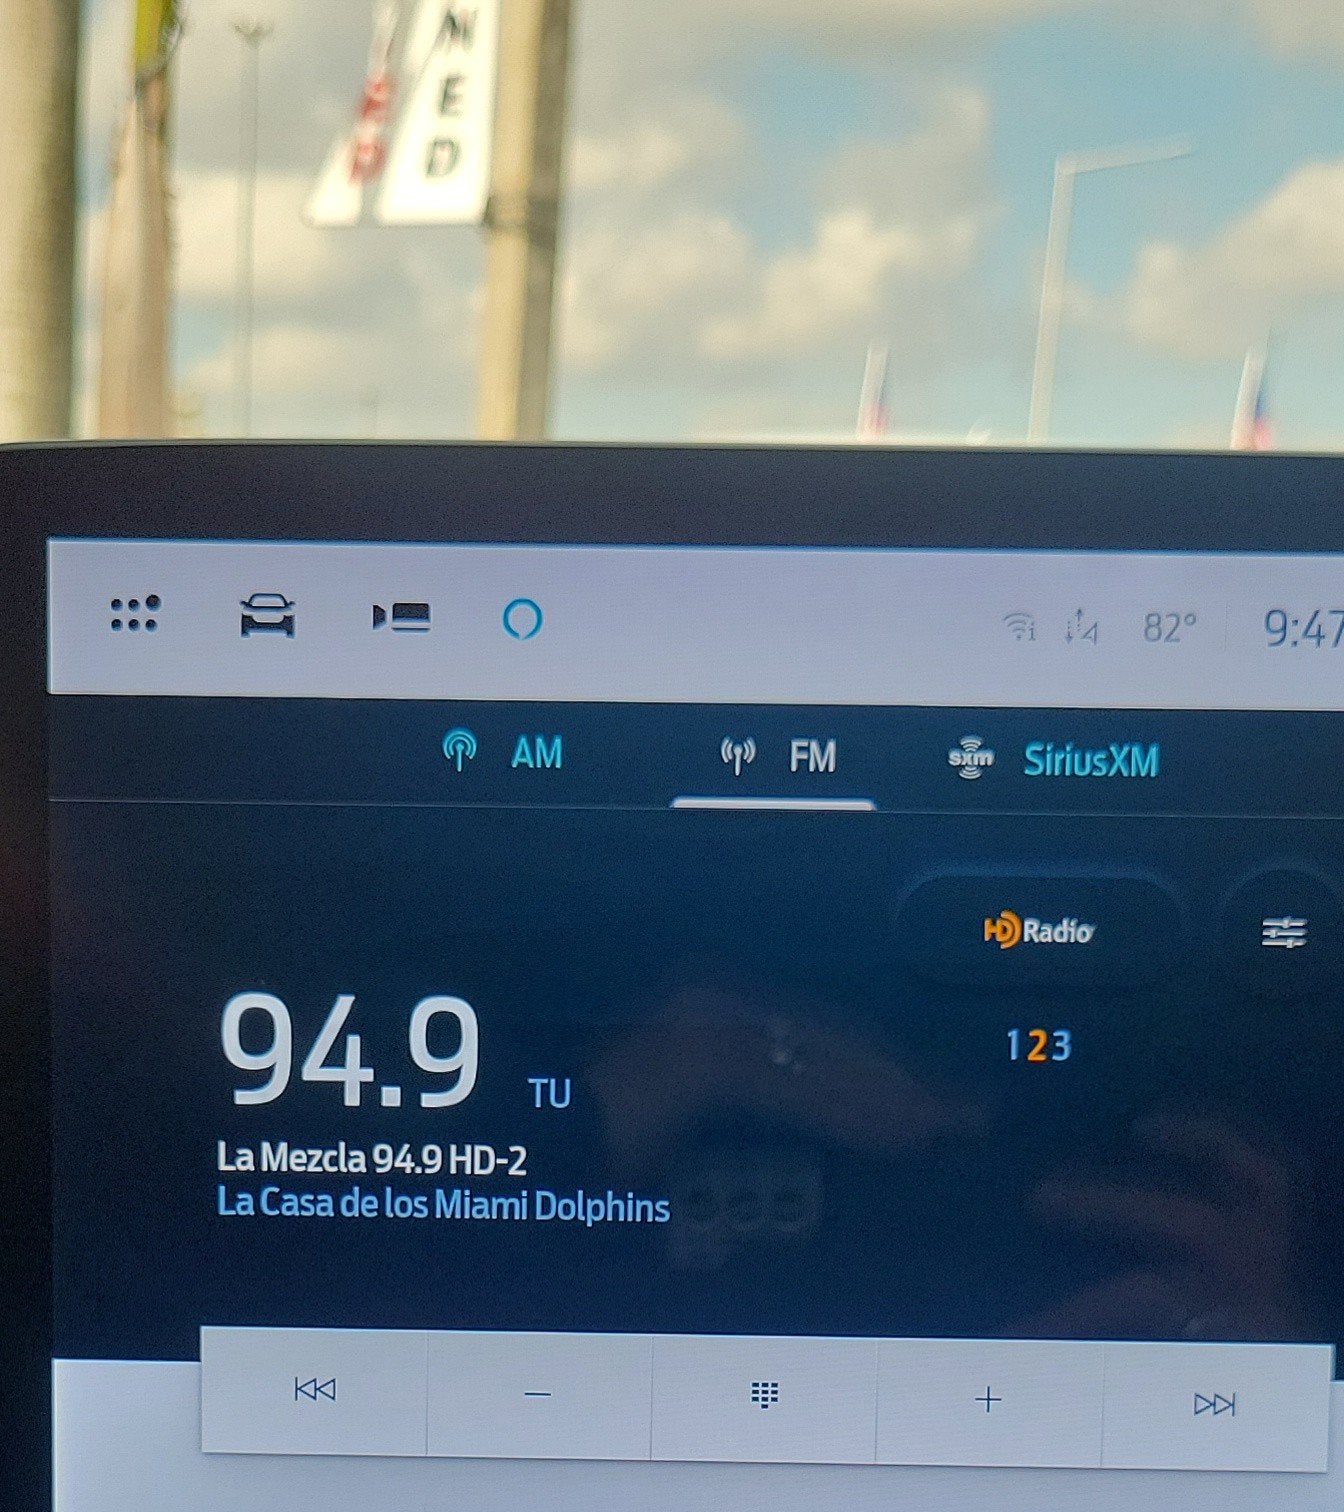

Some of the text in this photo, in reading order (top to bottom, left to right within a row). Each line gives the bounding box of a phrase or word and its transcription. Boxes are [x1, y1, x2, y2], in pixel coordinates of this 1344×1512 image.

[511, 735, 563, 770] AM
[791, 740, 836, 773] FM
[1024, 744, 1159, 777] SiriusXM
[1024, 918, 1096, 944] Radio
[221, 991, 571, 1109] 94.9 TU
[218, 1140, 527, 1176] La Mezcla 94.9 HD-2
[218, 1184, 671, 1228] La Casa de los Miami Dolphins
